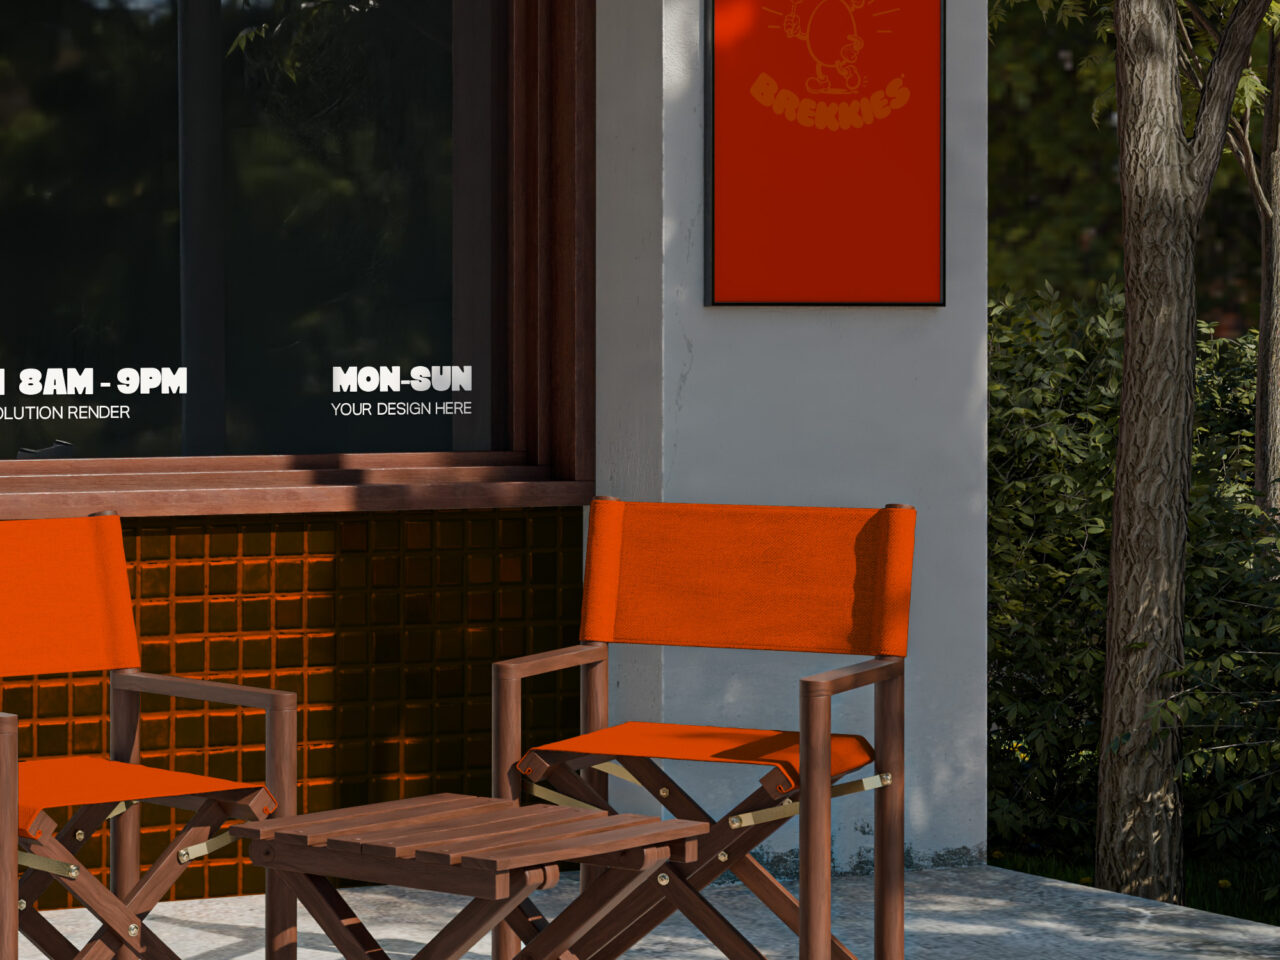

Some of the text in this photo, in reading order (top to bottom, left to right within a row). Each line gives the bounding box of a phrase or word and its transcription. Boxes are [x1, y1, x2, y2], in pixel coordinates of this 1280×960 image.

[750, 72, 911, 132] BREKKIES
[332, 366, 472, 392] MON-SUN
[68, 405, 130, 420] RENDER
[331, 401, 472, 416] YOUR DESIGN HERE
